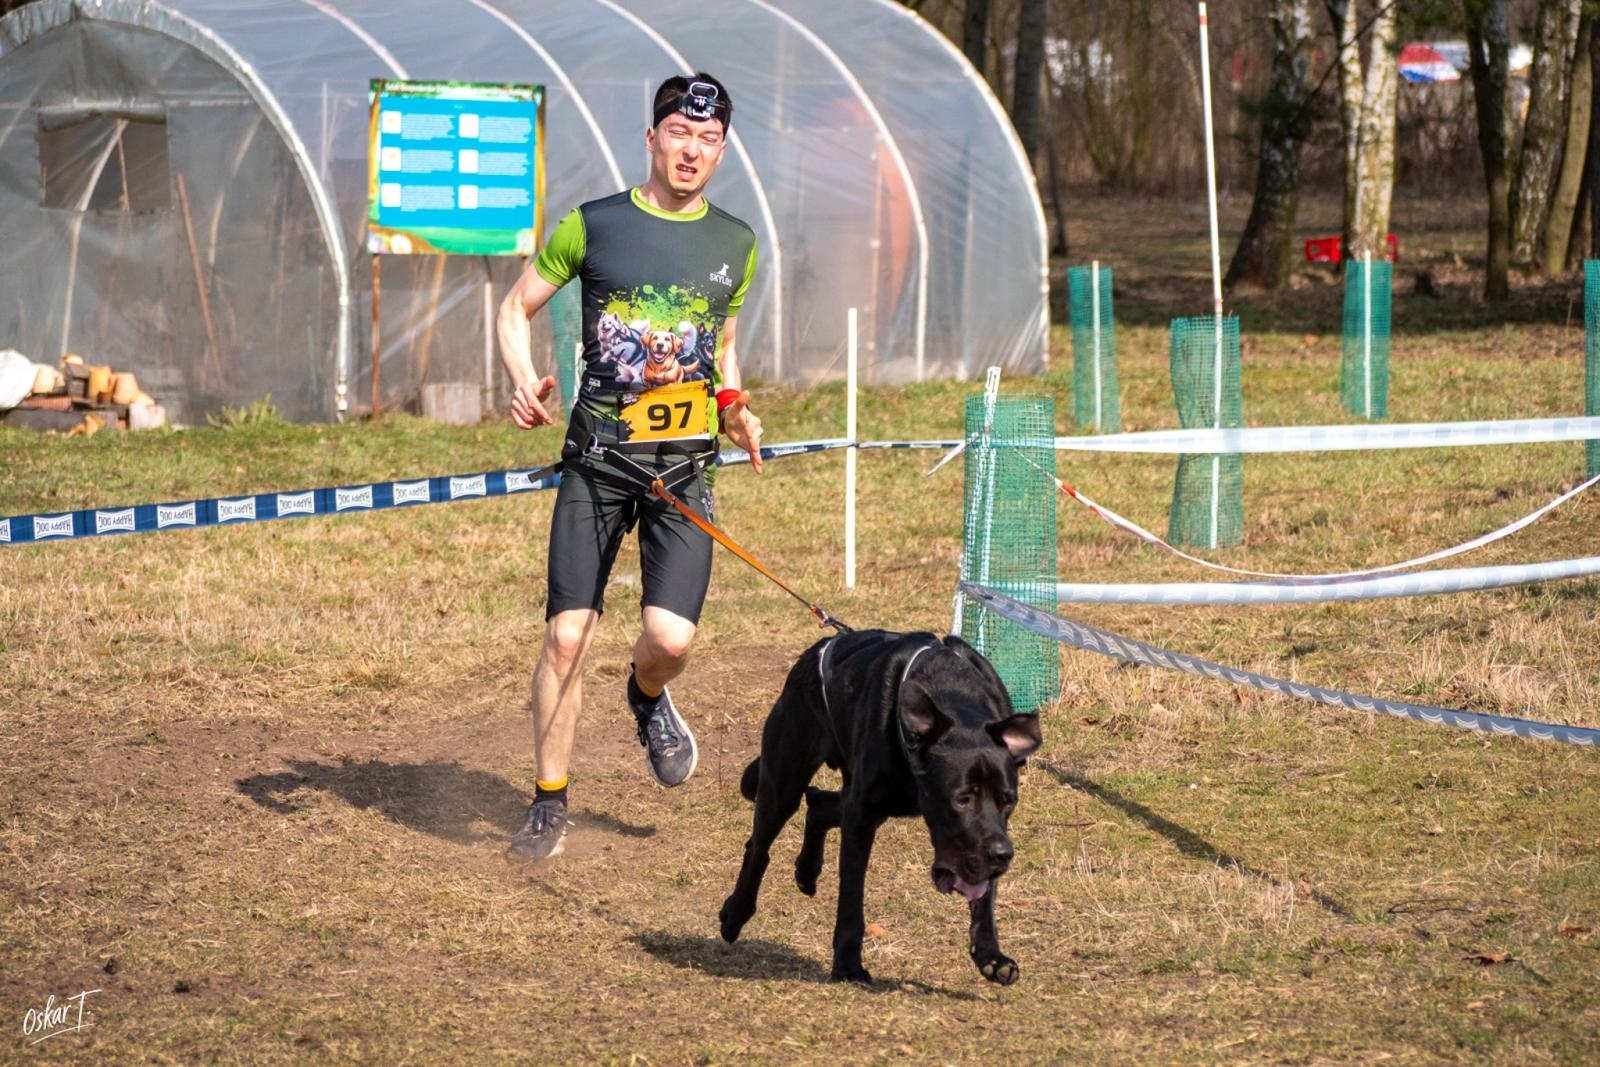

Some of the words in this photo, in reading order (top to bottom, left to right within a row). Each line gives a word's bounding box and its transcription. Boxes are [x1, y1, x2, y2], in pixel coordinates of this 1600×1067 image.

[647, 400, 693, 431] 97
[233, 502, 253, 514] HAPPY
[279, 499, 292, 511] DOG
[293, 496, 312, 509] HAPPY
[160, 510, 173, 522] DOG
[173, 507, 193, 520] HAPPY
[220, 505, 233, 517] DOG
[98, 515, 111, 527] DOG
[112, 513, 133, 525] HAPPY
[36, 521, 49, 534] DOG
[50, 519, 71, 532] HAPPY
